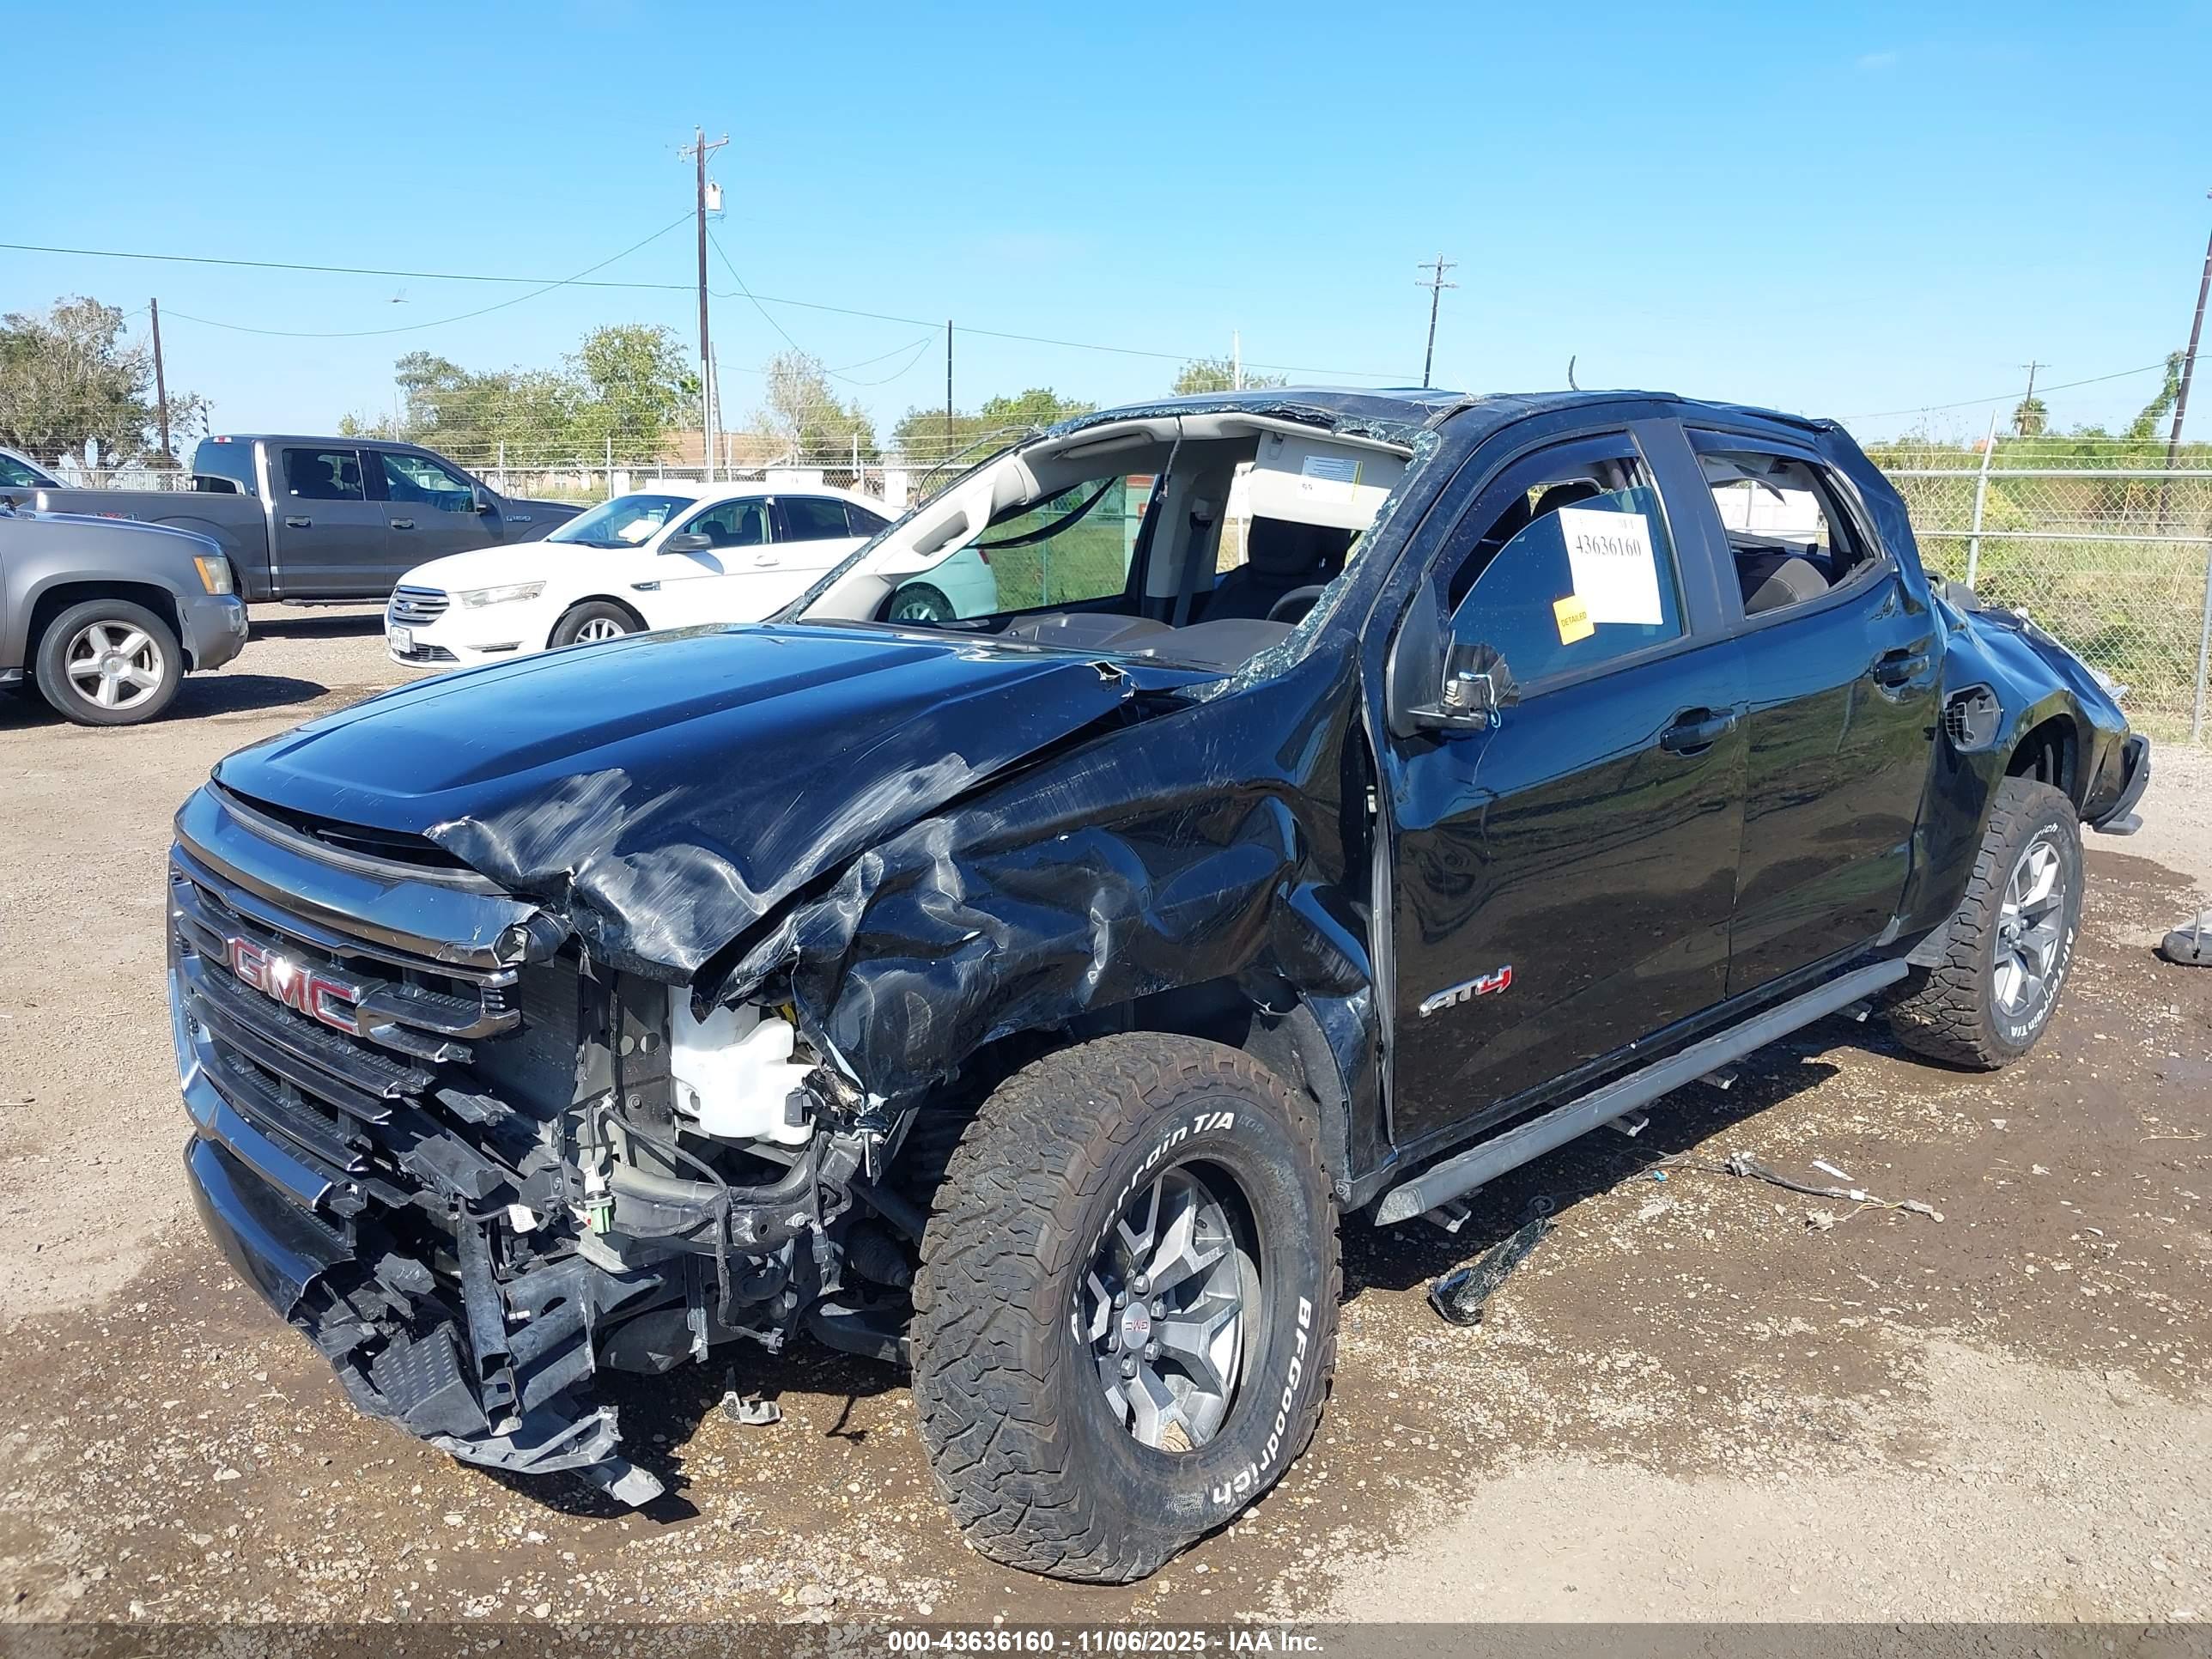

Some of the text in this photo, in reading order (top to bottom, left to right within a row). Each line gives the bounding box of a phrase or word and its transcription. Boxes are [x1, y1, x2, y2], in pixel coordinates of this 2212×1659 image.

[1575, 534, 1642, 557] 43636160
[1560, 611, 1588, 627] DETAILED
[232, 934, 362, 1036] GMC
[1419, 964, 1512, 1018] AT4
[1192, 1111, 1236, 1136] T/A
[1125, 1319, 1148, 1332] GMC
[1212, 1296, 1313, 1506] BFGoodrich
